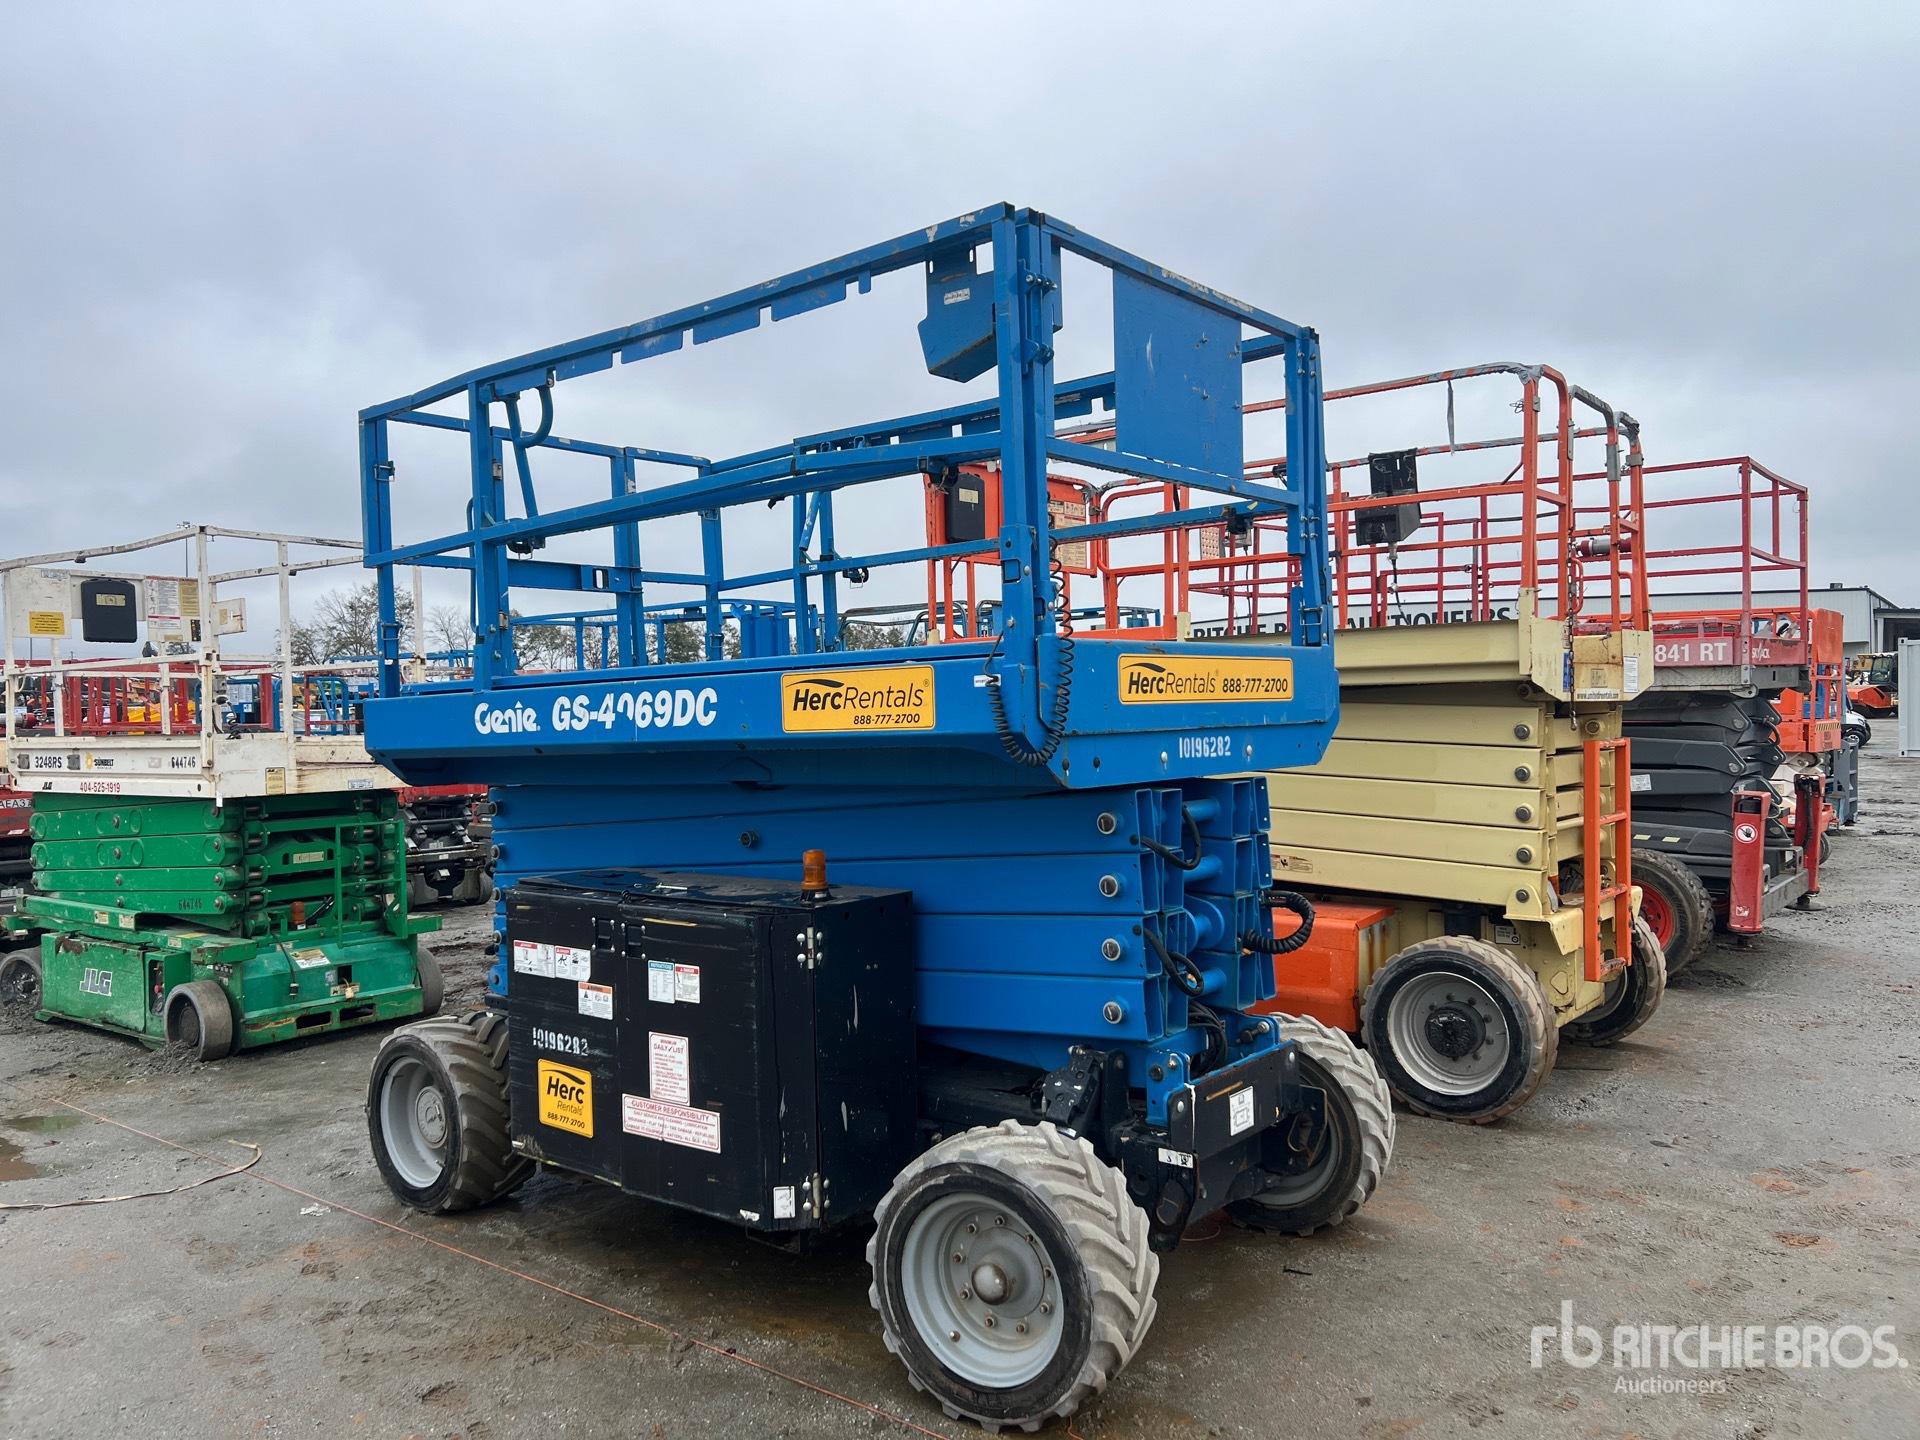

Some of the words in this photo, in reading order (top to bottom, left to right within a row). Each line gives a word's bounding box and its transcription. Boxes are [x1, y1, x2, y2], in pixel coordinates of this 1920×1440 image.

[1346, 607, 1511, 629] AUTIONEERS
[1194, 622, 1266, 638] RITHE
[1700, 642, 1727, 661] RT
[1222, 678, 1288, 693] 888-777-2700
[474, 700, 540, 734] Genie
[853, 713, 920, 725] 888-777-2700
[1179, 736, 1231, 759] 10196282
[35, 757, 62, 769] 3248RS
[171, 757, 196, 769] 644746
[80, 782, 121, 793] 404-525-1919
[79, 967, 113, 997] JLG
[533, 1027, 590, 1057] 10196282
[673, 1046, 684, 1054] LIST
[547, 1076, 585, 1104] Herc
[557, 1100, 584, 1116] Rentals
[631, 1099, 662, 1112] CUSTOMER
[663, 1105, 710, 1121] RESPONSIBILITY
[547, 1112, 586, 1129] 888-777-2700
